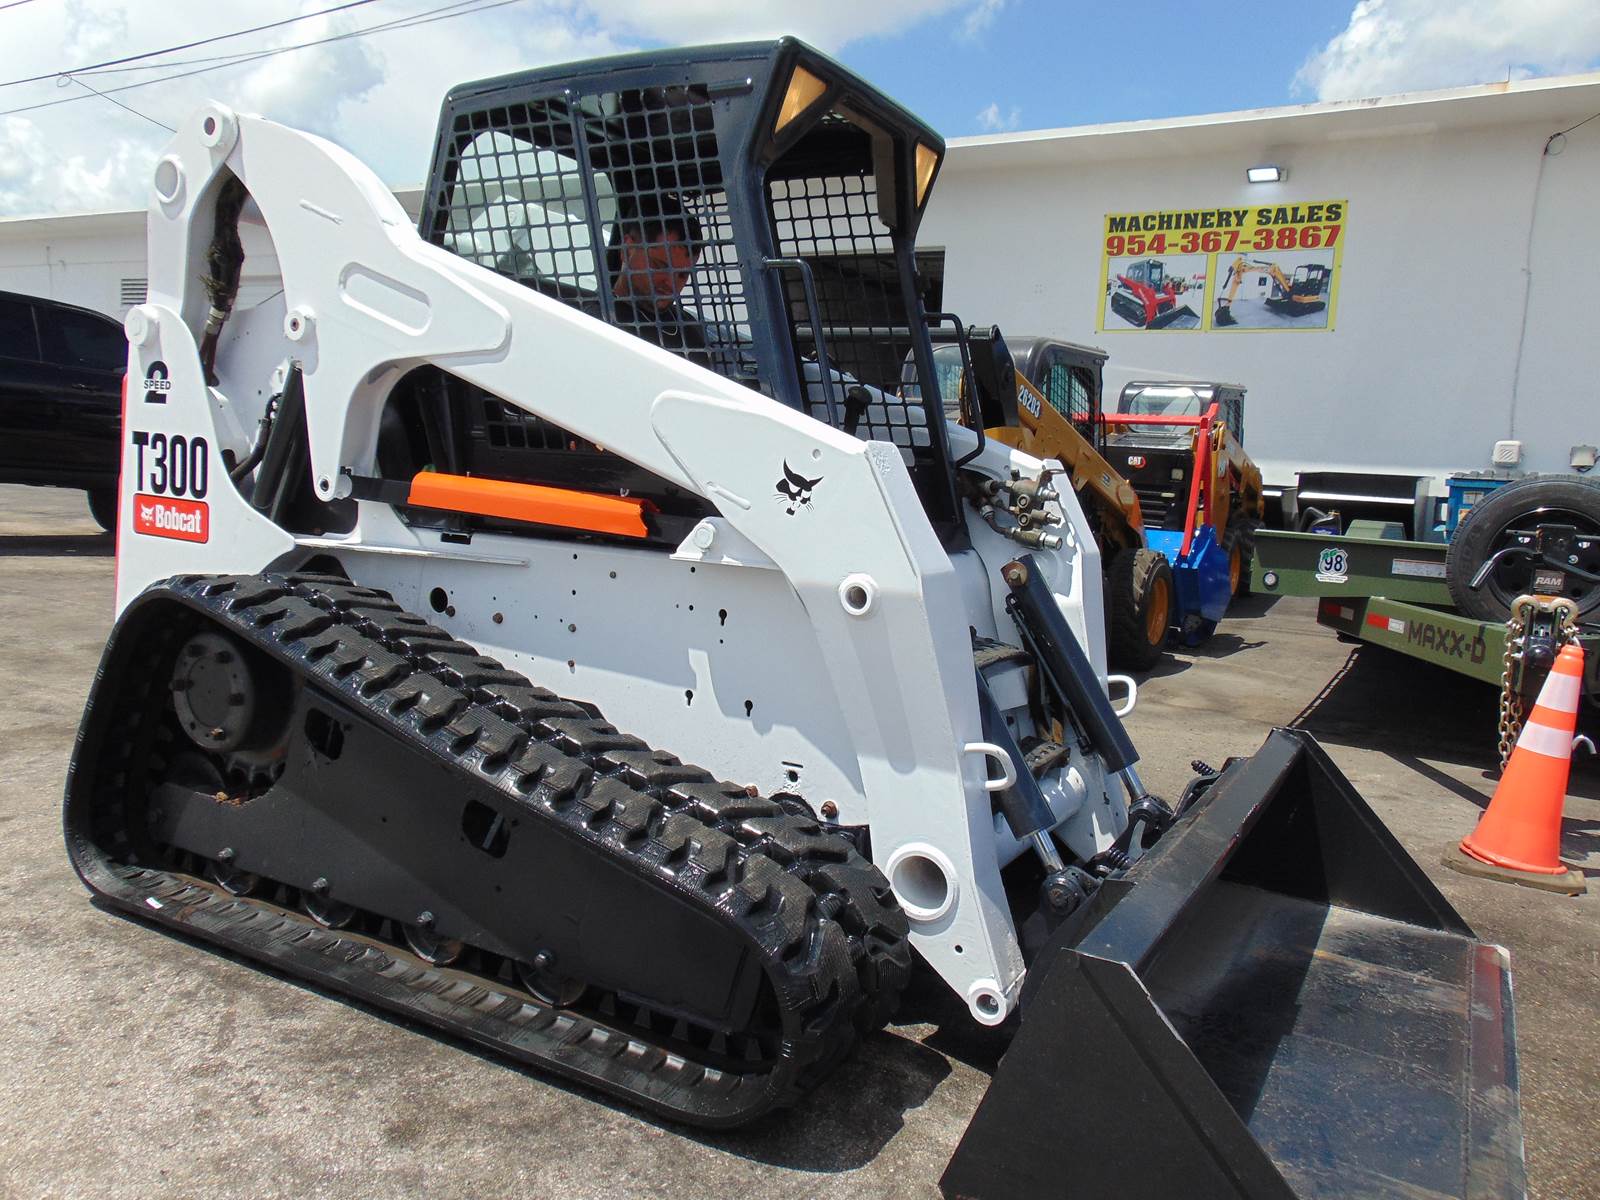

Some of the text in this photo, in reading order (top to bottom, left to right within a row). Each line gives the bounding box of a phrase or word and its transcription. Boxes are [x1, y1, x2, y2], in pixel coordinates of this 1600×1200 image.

[1108, 204, 1342, 233] MACHINERY SALES
[1106, 225, 1342, 256] 954-367-3867
[144, 380, 171, 390] SPEED
[145, 361, 168, 404] 2
[132, 431, 209, 499] T300
[1128, 456, 1142, 465] CAT
[155, 504, 201, 534] Bobcat
[1325, 554, 1343, 571] 98
[1535, 576, 1562, 586] RAM
[1407, 620, 1486, 664] MAXX-D
